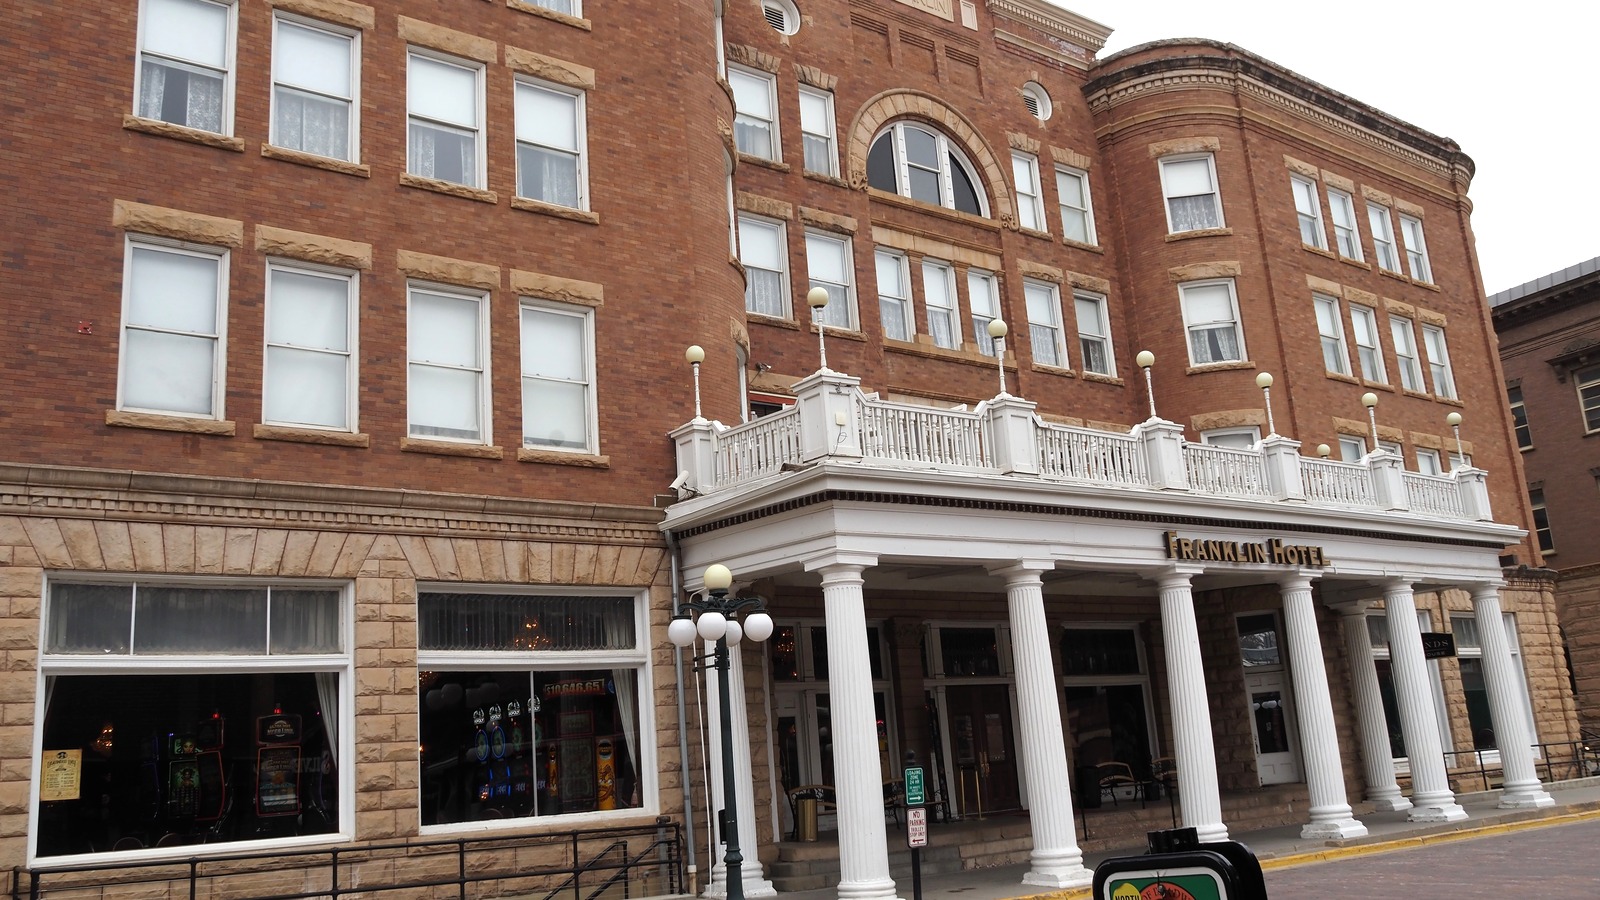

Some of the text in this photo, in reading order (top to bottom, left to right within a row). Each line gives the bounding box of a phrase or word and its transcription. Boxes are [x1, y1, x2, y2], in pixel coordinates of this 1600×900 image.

[1163, 530, 1331, 566] FRANKLIN HOTEL
[1425, 640, 1448, 648] NDS
